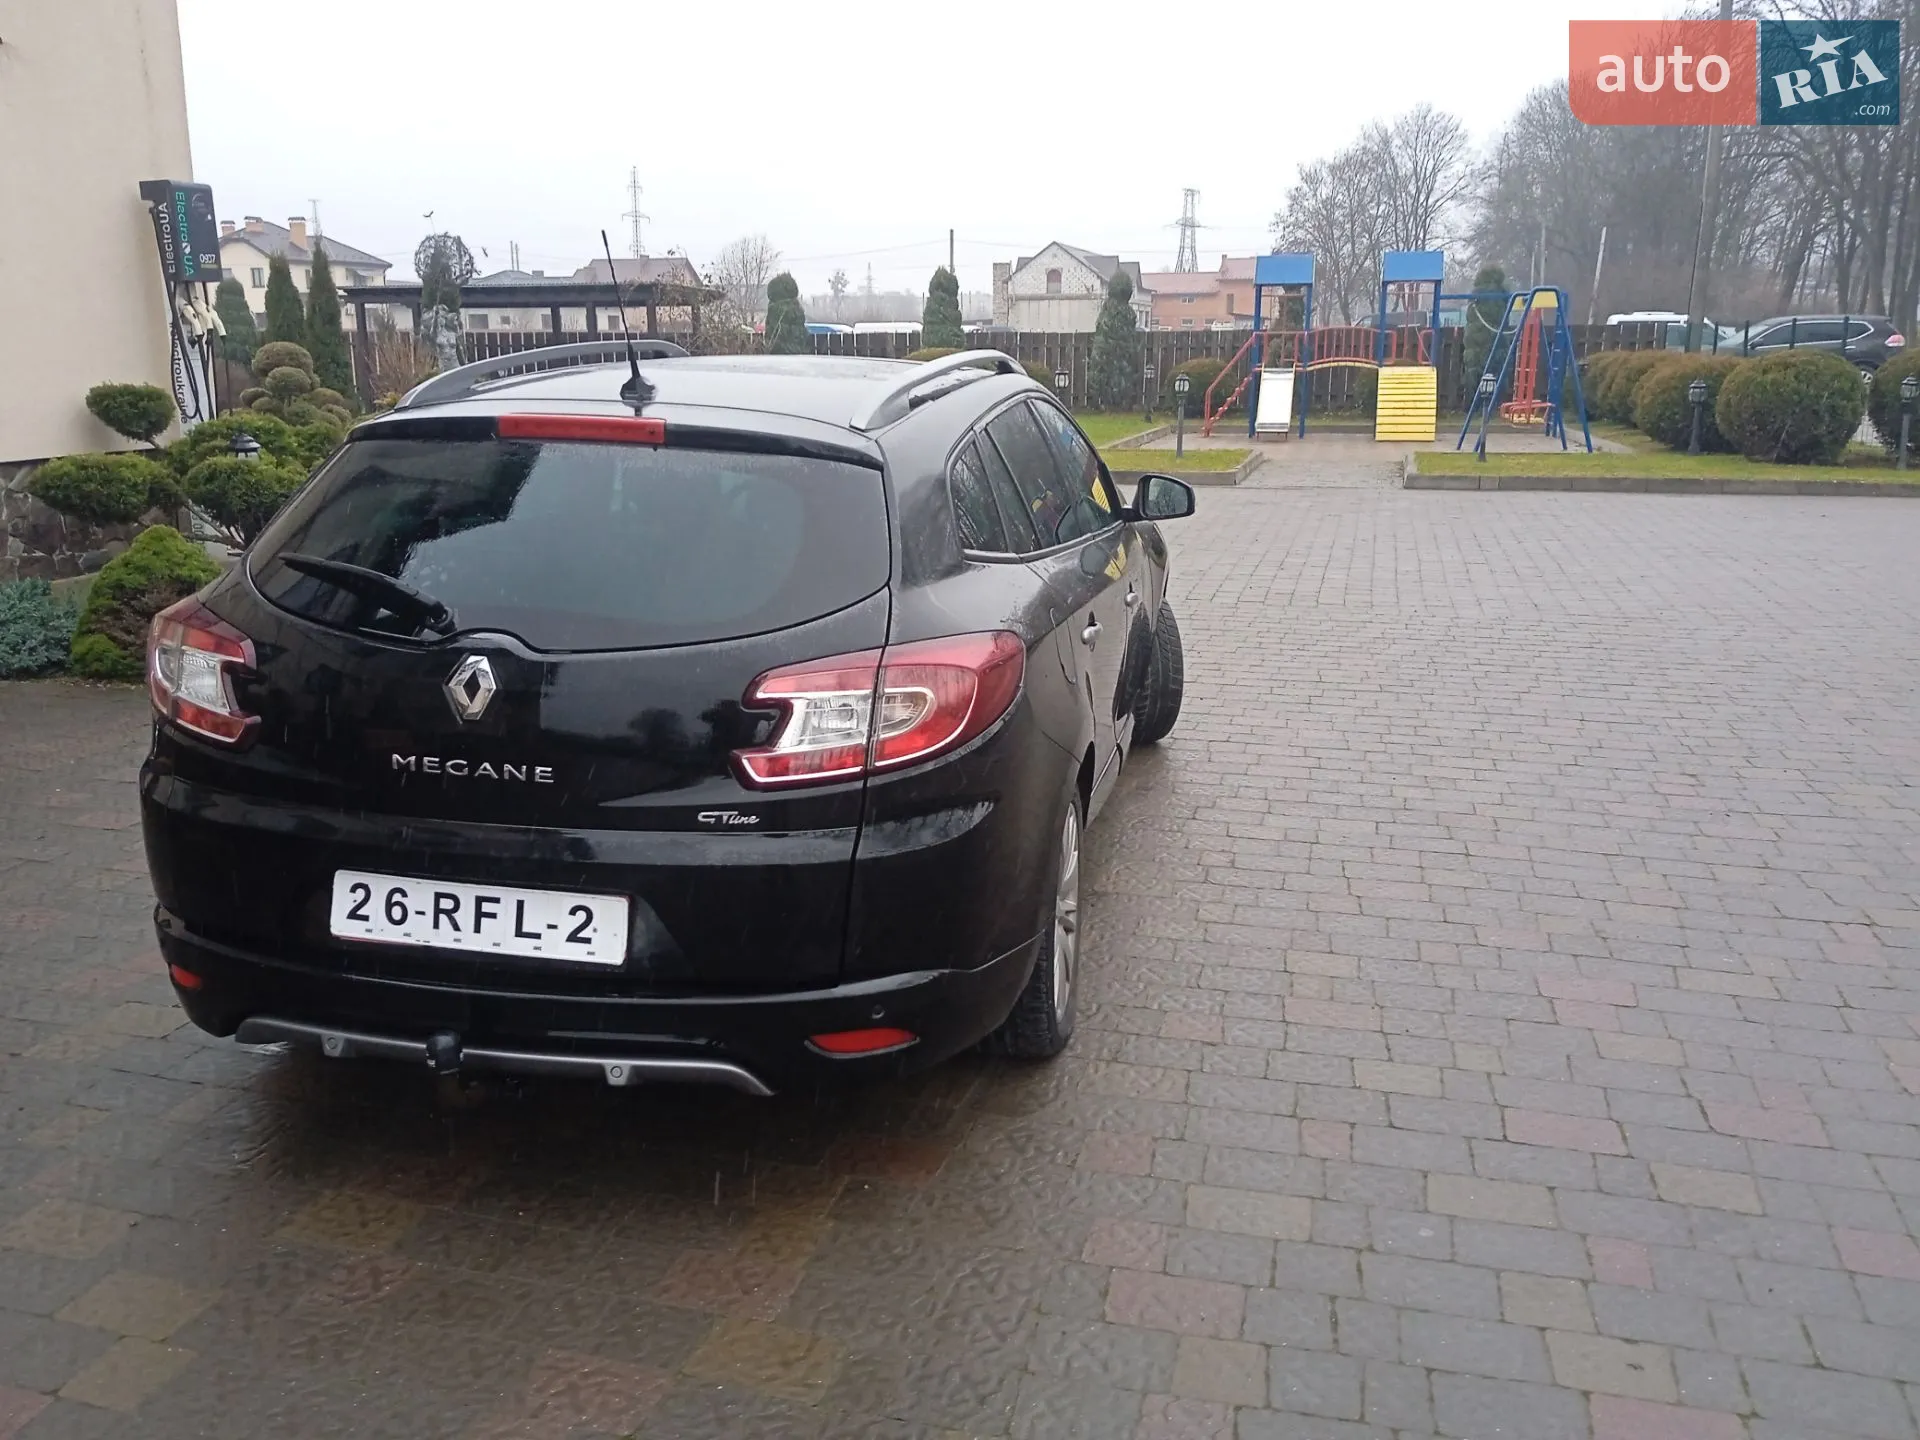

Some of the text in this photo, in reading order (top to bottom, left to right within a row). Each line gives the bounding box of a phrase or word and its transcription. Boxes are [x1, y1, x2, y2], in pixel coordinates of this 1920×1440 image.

[158, 202, 176, 273] ElectroUA
[391, 753, 554, 783] MEGANE
[346, 882, 595, 945] 26-RFL-2
